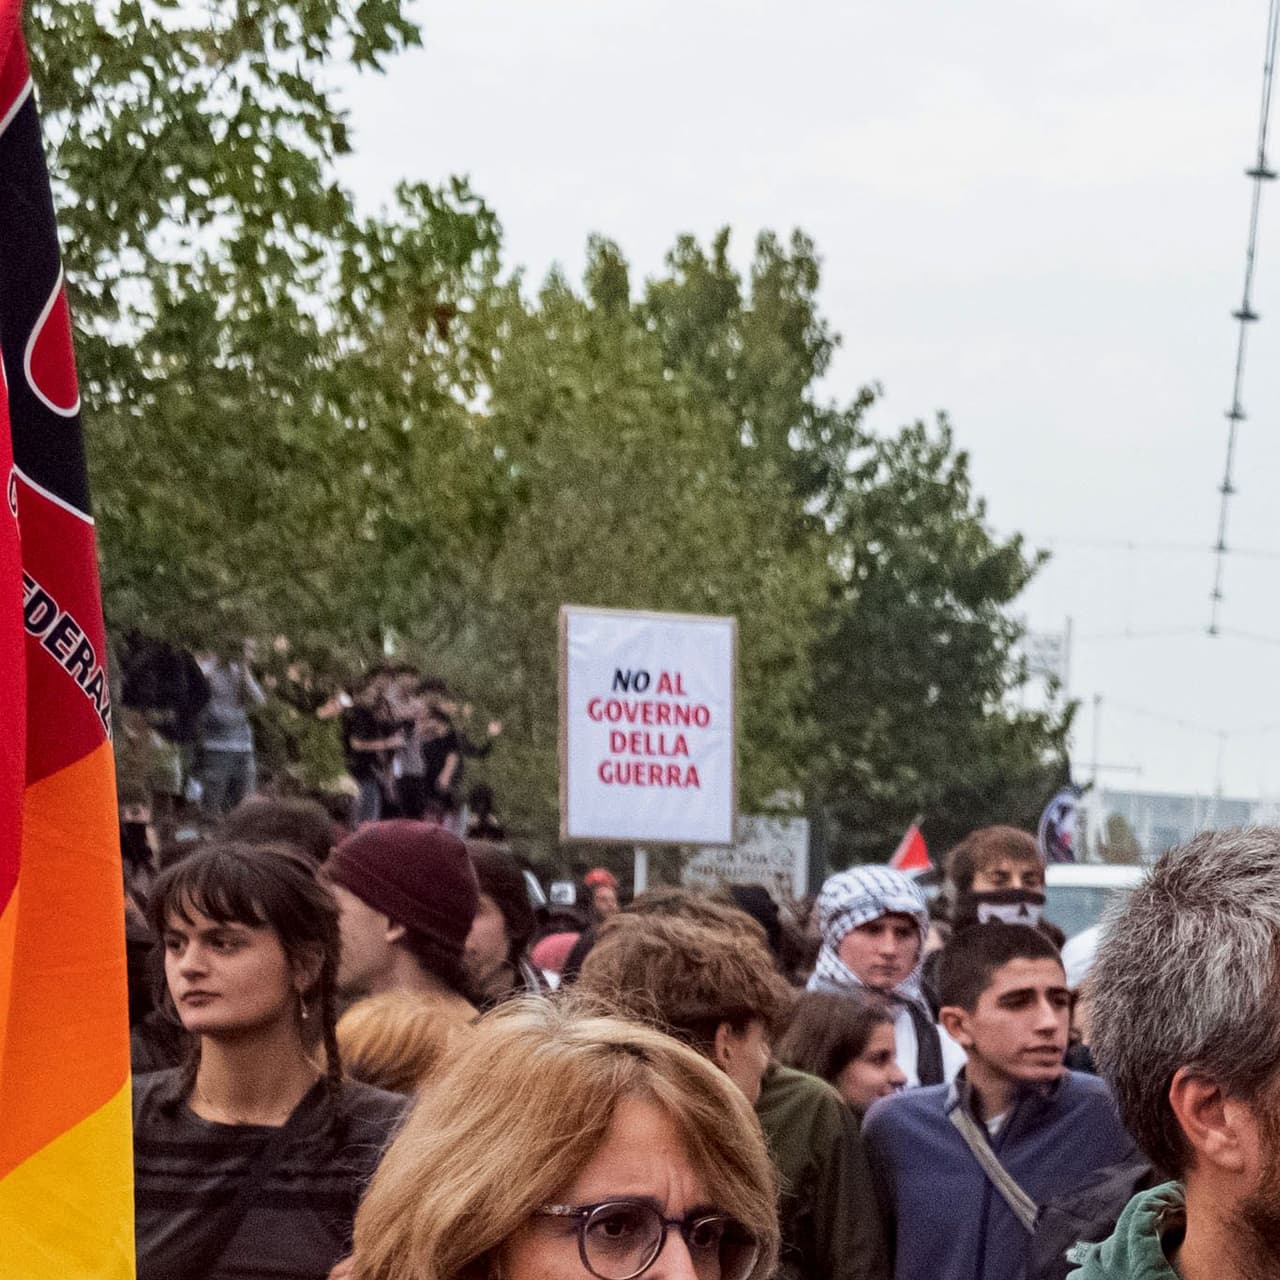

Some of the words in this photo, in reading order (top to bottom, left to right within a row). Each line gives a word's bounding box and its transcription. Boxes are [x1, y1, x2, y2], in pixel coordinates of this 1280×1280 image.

[22, 567, 113, 741] DERA
[612, 667, 651, 694] NO
[656, 670, 688, 697] AL
[586, 696, 712, 729] GOVERNO
[608, 730, 690, 758] DELLA
[597, 760, 702, 790] GUERRA
